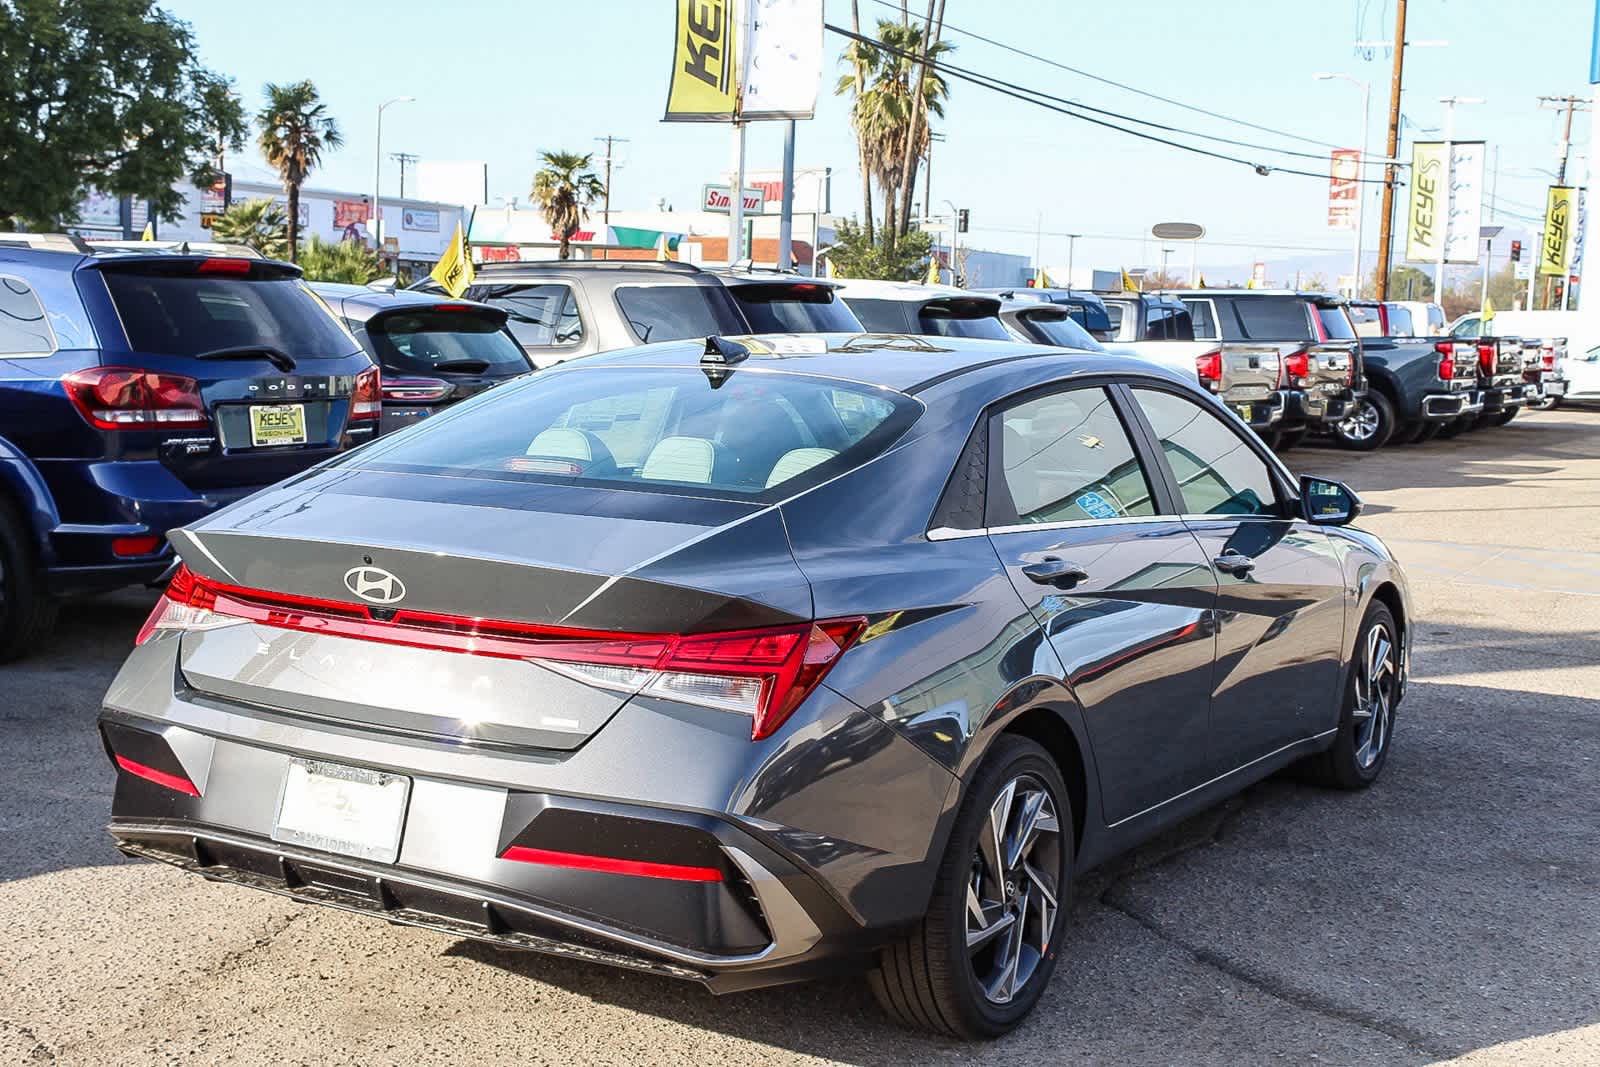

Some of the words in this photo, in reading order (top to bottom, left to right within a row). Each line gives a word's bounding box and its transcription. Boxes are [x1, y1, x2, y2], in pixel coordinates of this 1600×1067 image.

[684, 0, 722, 88] KE
[707, 191, 760, 209] Sinir
[1414, 154, 1441, 248] KEYES
[1546, 195, 1568, 266] KEYES
[248, 383, 326, 391] DODGE
[260, 411, 297, 428] KEYES
